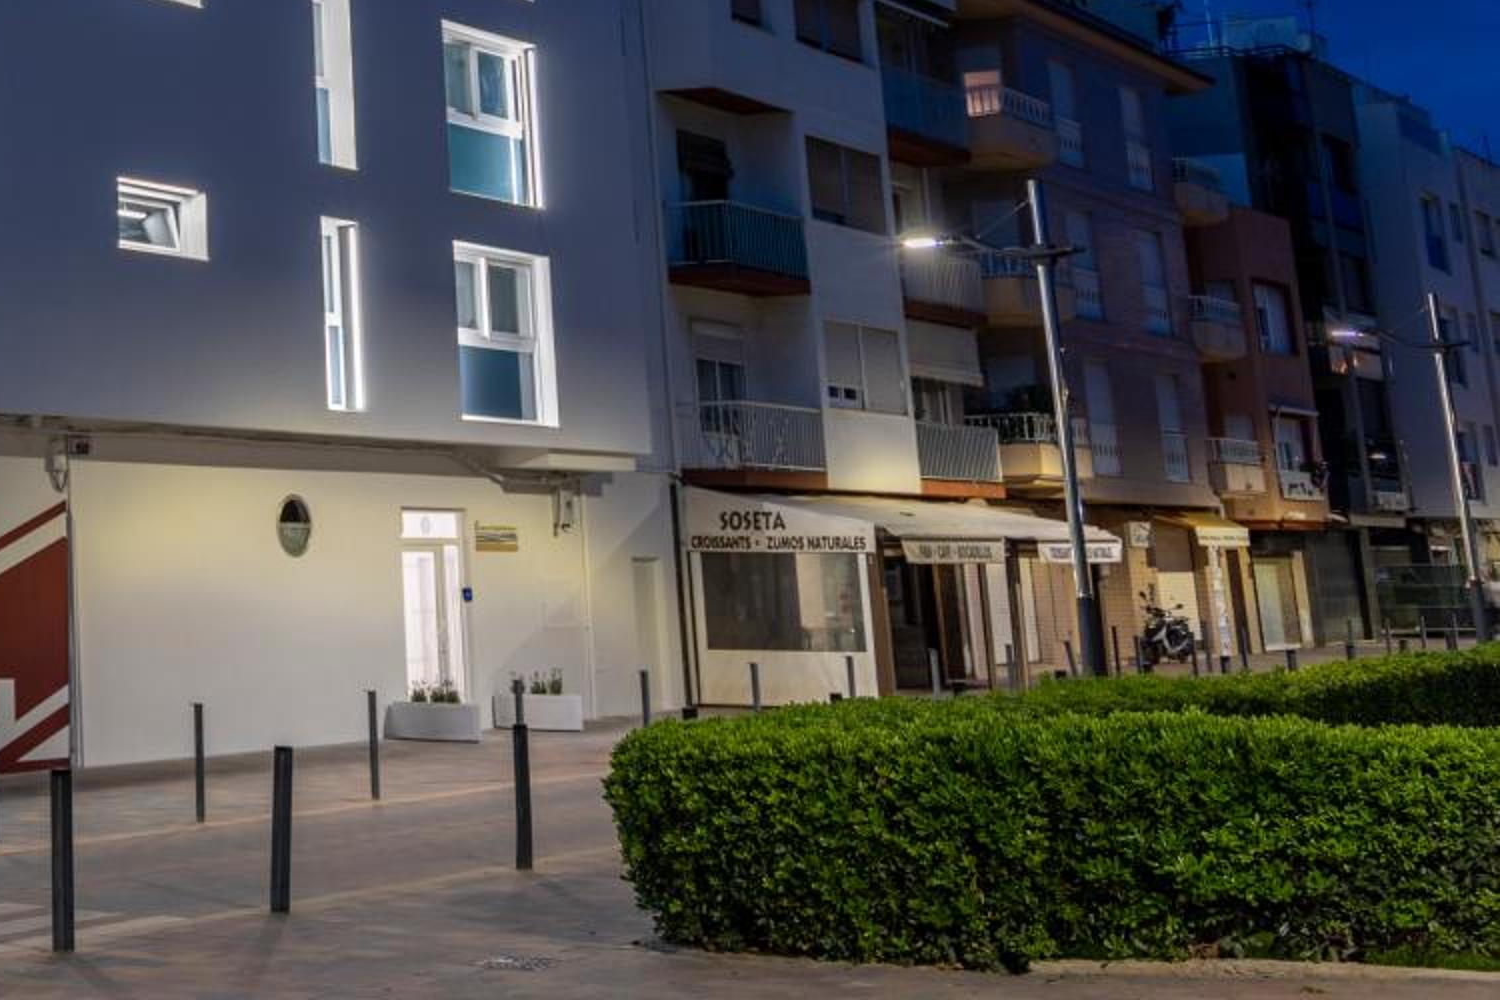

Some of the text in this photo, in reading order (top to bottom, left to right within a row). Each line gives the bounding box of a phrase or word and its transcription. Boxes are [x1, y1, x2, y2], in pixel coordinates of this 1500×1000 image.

[719, 511, 787, 531] SOSETA
[691, 535, 867, 550] CROISSANTS ZUMOS NATURALES
